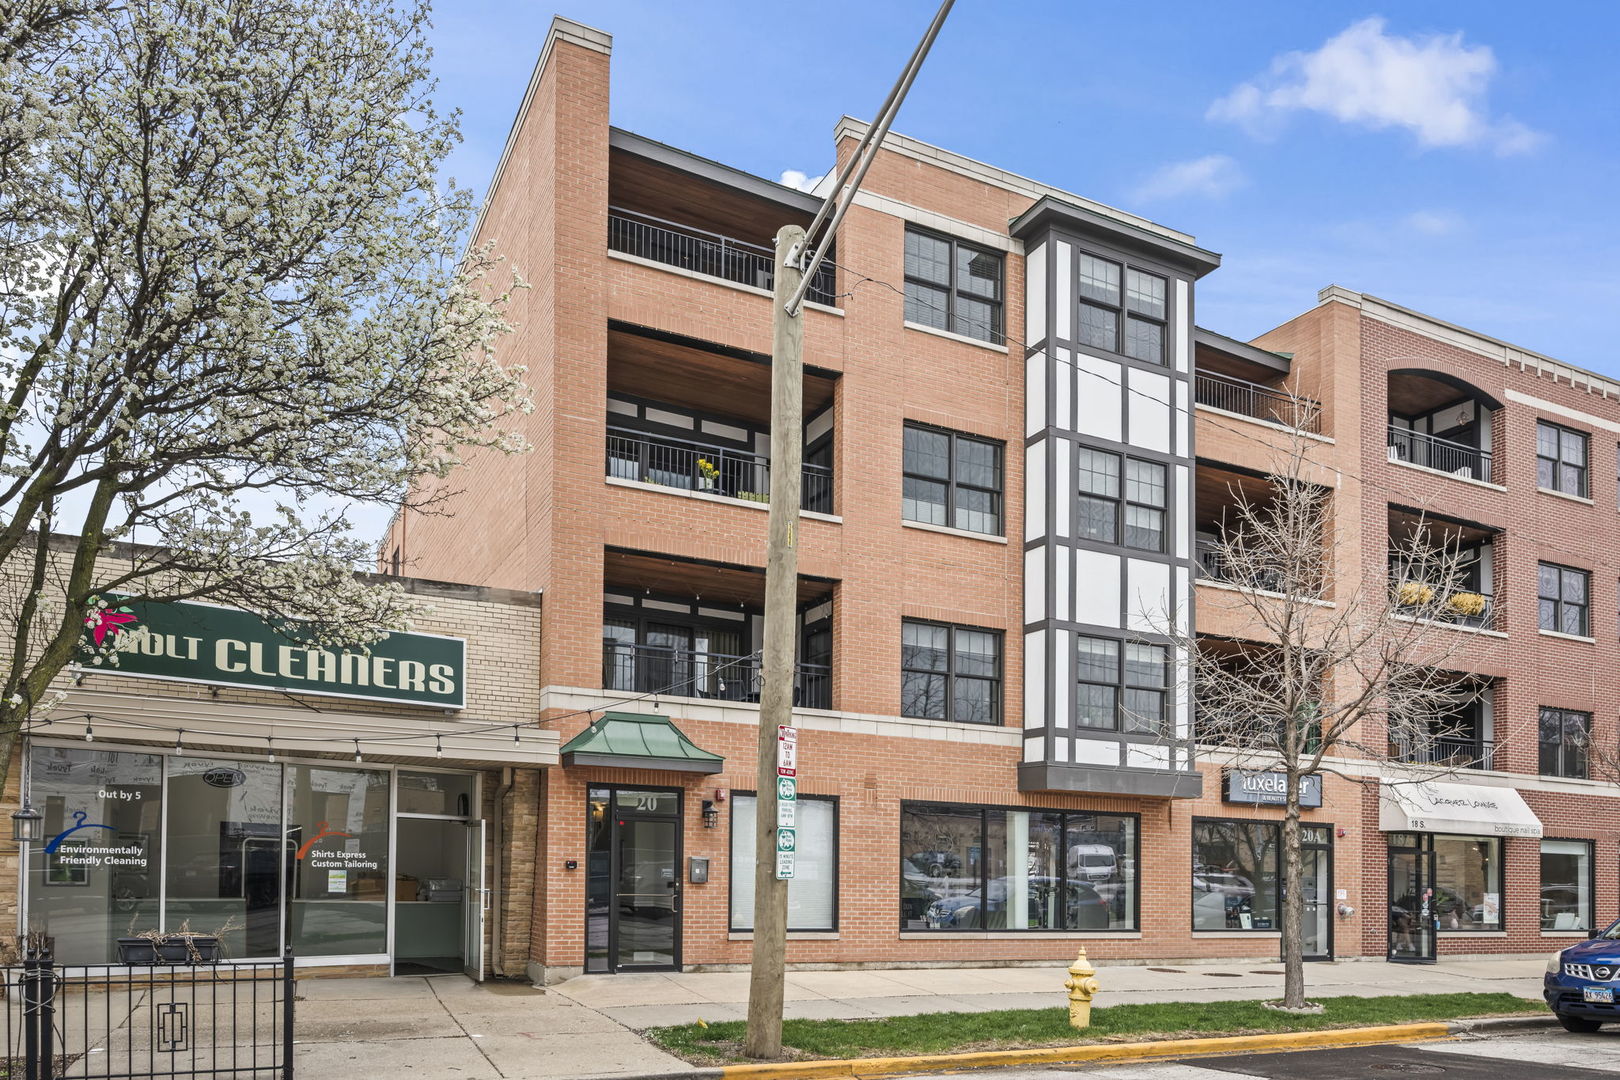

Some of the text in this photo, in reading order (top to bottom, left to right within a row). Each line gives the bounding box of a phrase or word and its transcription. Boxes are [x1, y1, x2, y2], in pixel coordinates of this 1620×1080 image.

[215, 638, 455, 695] CLEANERS
[204, 772, 242, 784] OPEN
[1243, 772, 1309, 793] luxelar
[98, 789, 141, 802] Out by 5
[637, 797, 657, 811] 20
[1411, 820, 1418, 828] 18
[1494, 825, 1519, 834] boutique
[1301, 830, 1320, 842] 20A
[60, 845, 143, 857] Environmentally
[311, 850, 366, 859] Shirts Express
[60, 856, 147, 867] Friendly Cleaning
[311, 860, 378, 870] Custom Tailoring
